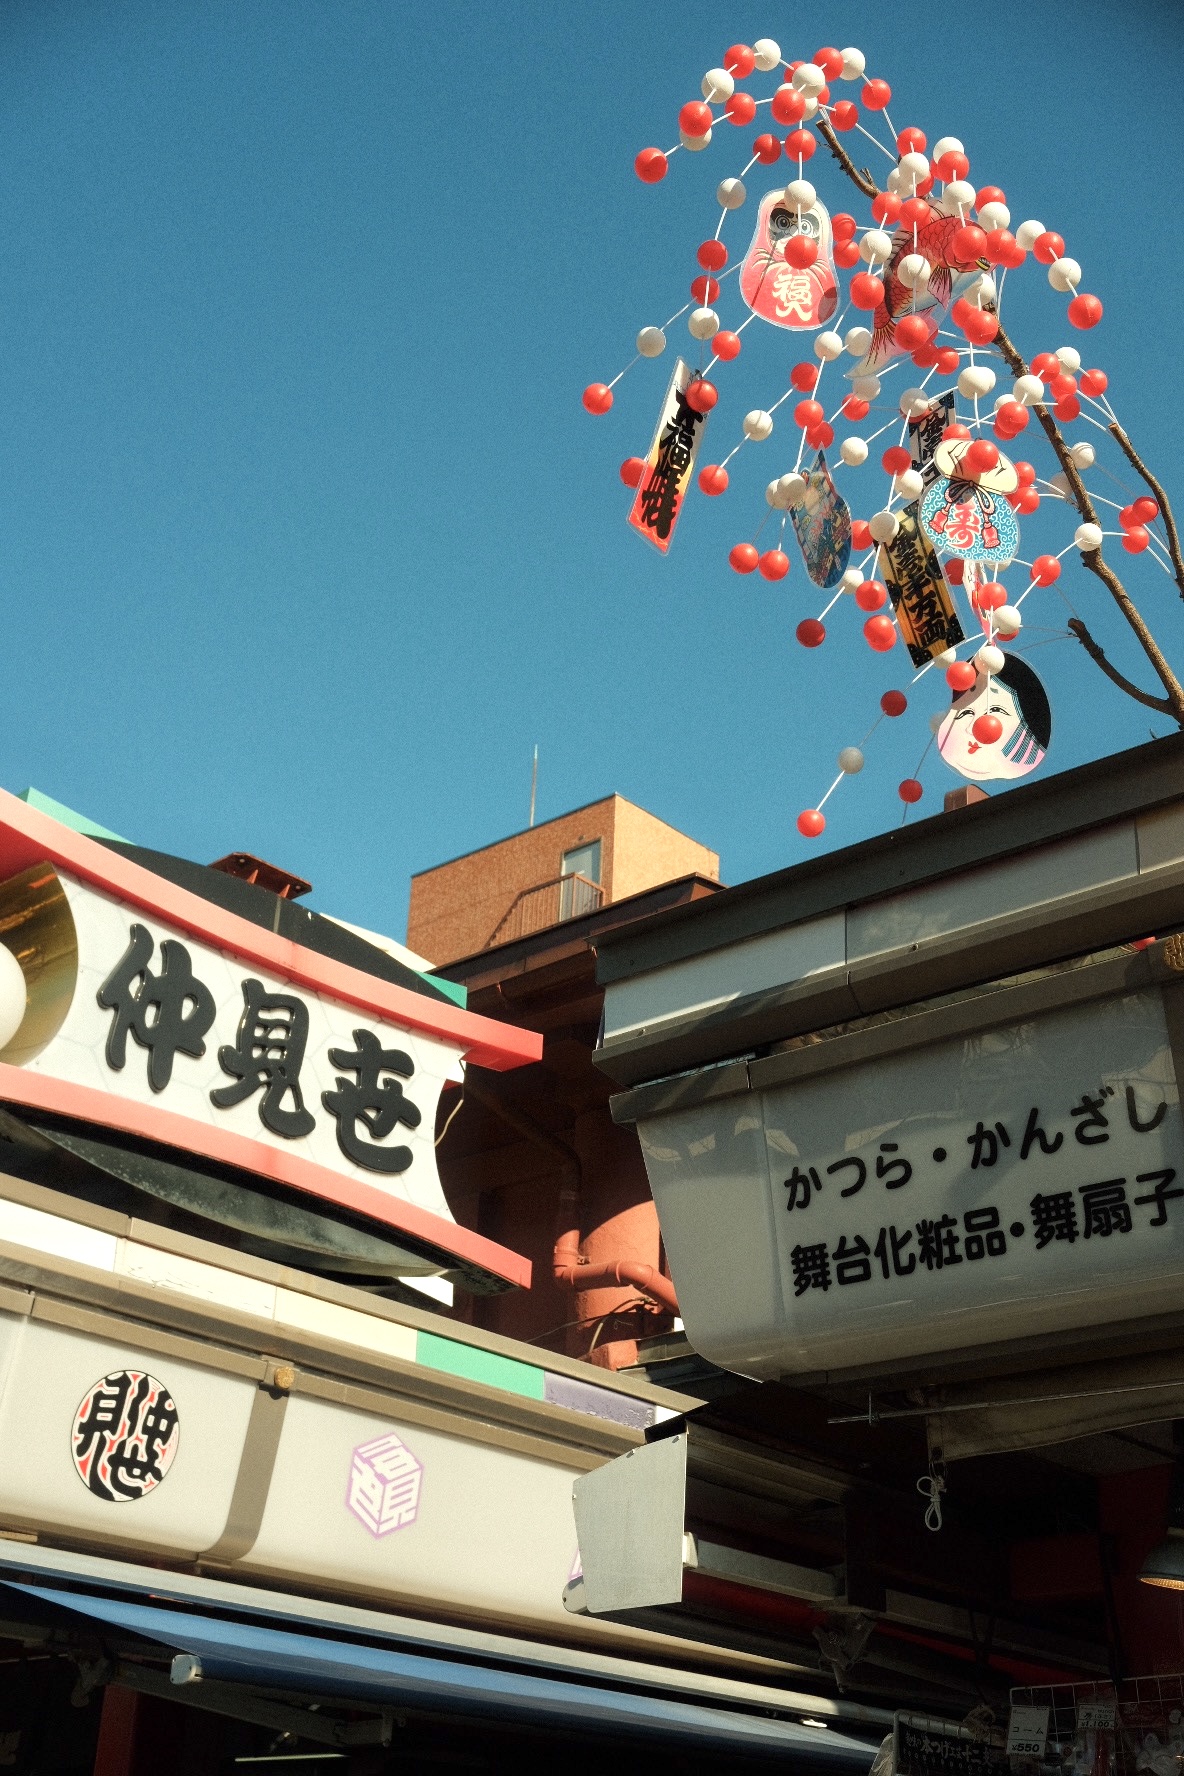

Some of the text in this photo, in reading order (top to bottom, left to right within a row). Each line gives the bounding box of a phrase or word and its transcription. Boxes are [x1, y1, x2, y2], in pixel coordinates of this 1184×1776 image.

[946, 502, 981, 549] 寿
[96, 923, 422, 1175] 仲見世
[784, 1086, 1168, 1212] かつら・かんざし
[790, 1168, 1184, 1297] 舞台化粧品・舞扇子
[1012, 1726, 1044, 1735] コーム
